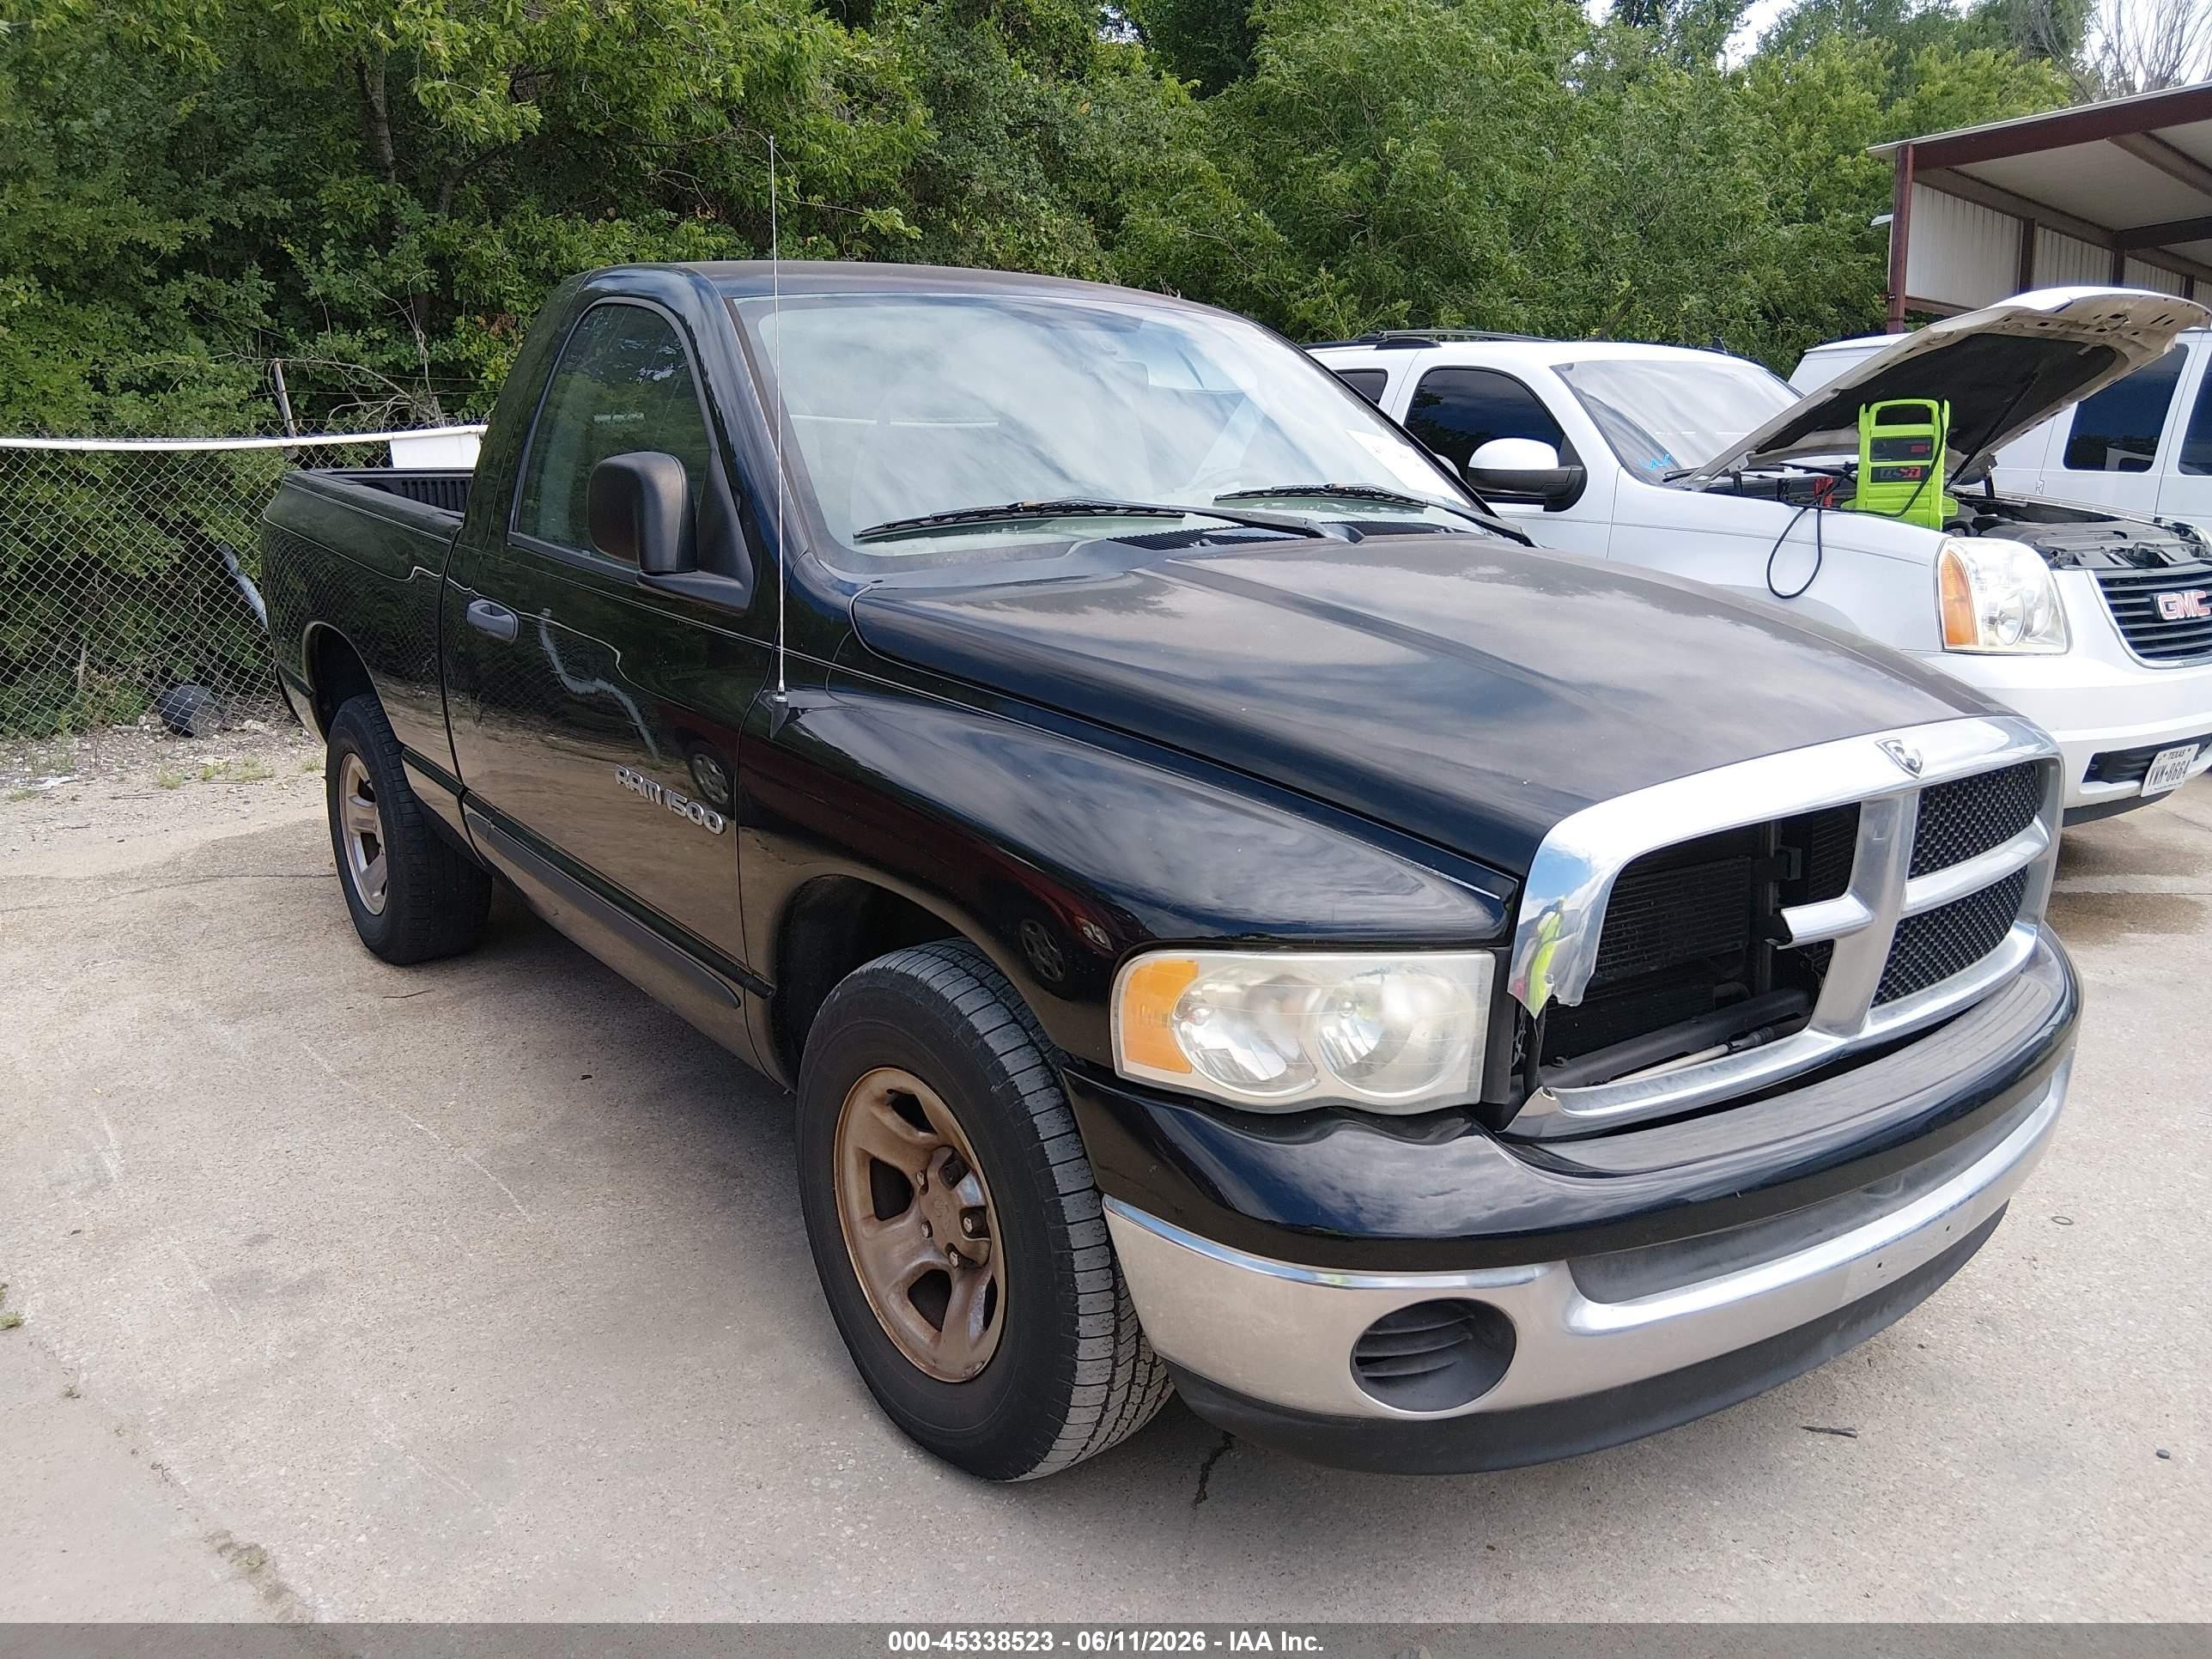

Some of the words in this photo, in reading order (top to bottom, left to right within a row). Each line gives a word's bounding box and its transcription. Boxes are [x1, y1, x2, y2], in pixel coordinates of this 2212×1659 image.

[2157, 589, 2211, 620] GMC
[2168, 748, 2186, 760] TEXAS
[615, 764, 662, 805] RAM
[664, 788, 726, 835] 1500
